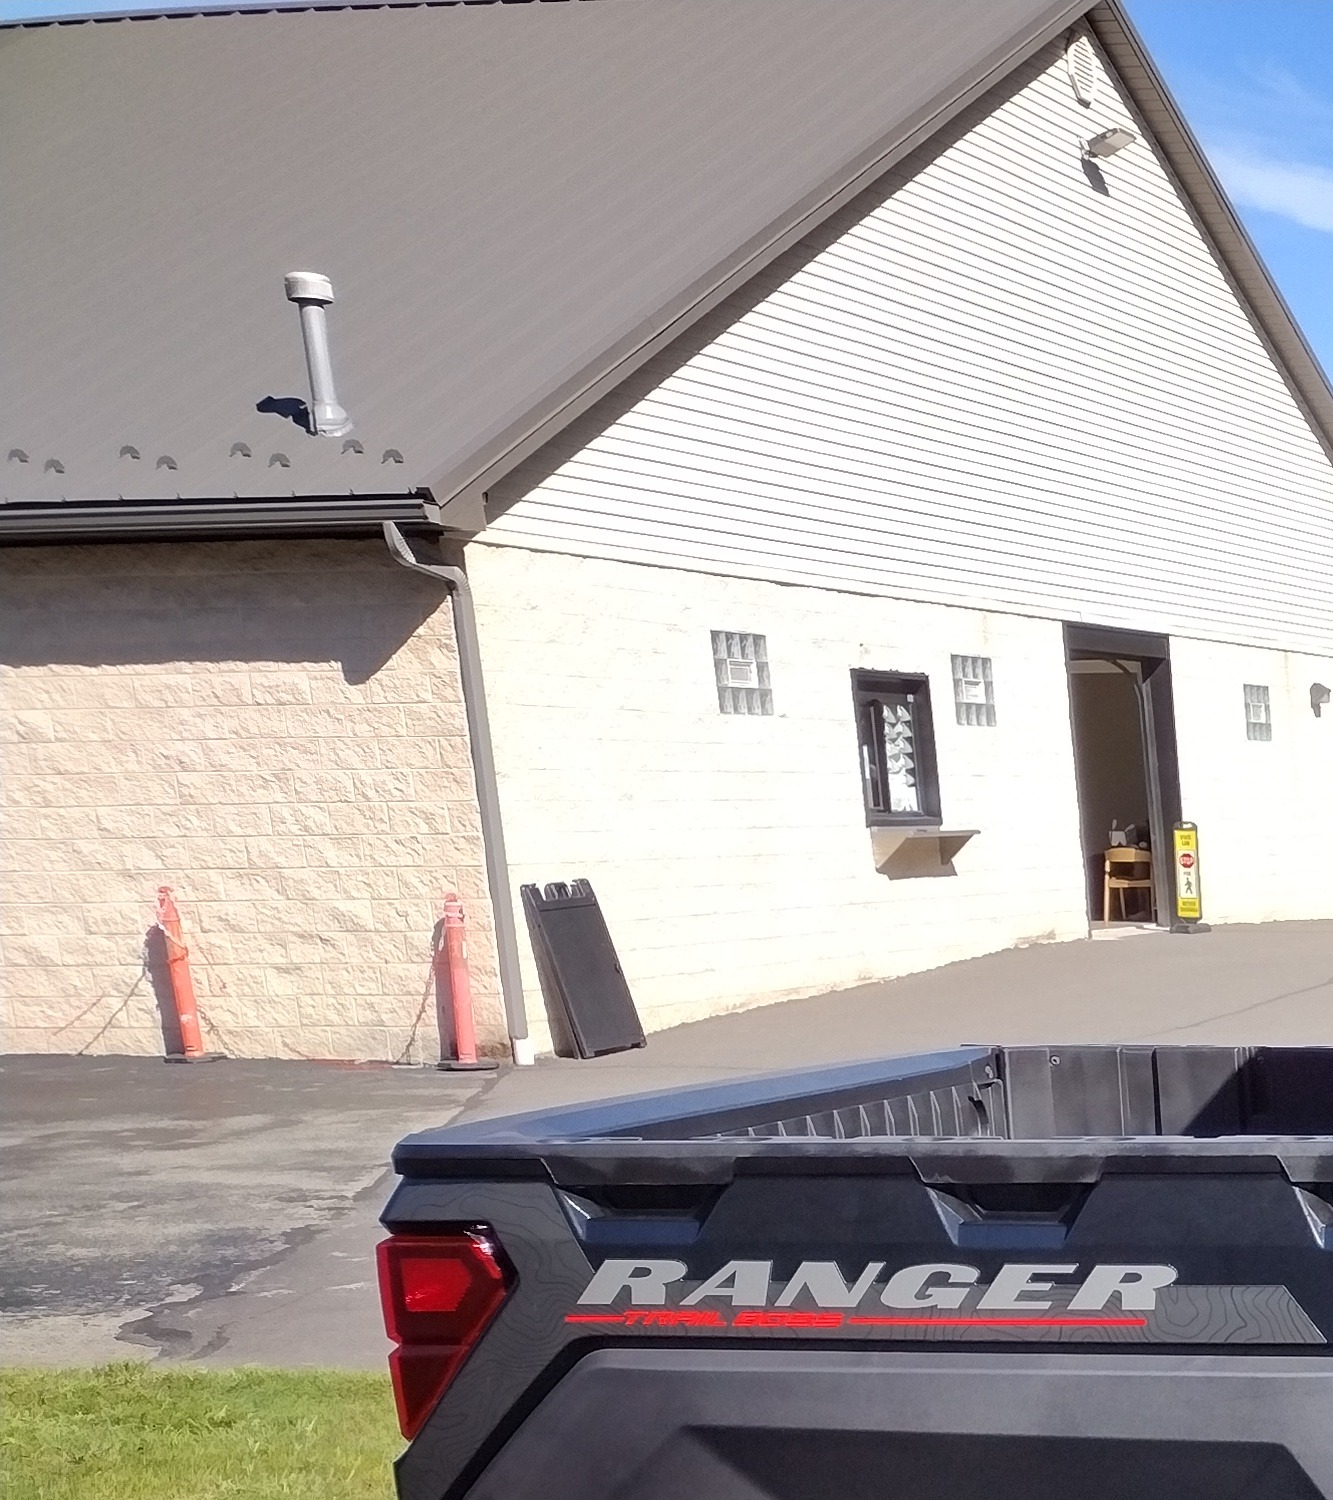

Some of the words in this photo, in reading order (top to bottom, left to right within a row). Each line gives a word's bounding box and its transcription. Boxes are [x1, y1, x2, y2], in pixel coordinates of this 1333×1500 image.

[576, 1259, 1178, 1312] RANGER
[624, 1309, 727, 1327] TRAIL
[732, 1310, 843, 1328] BOSS
